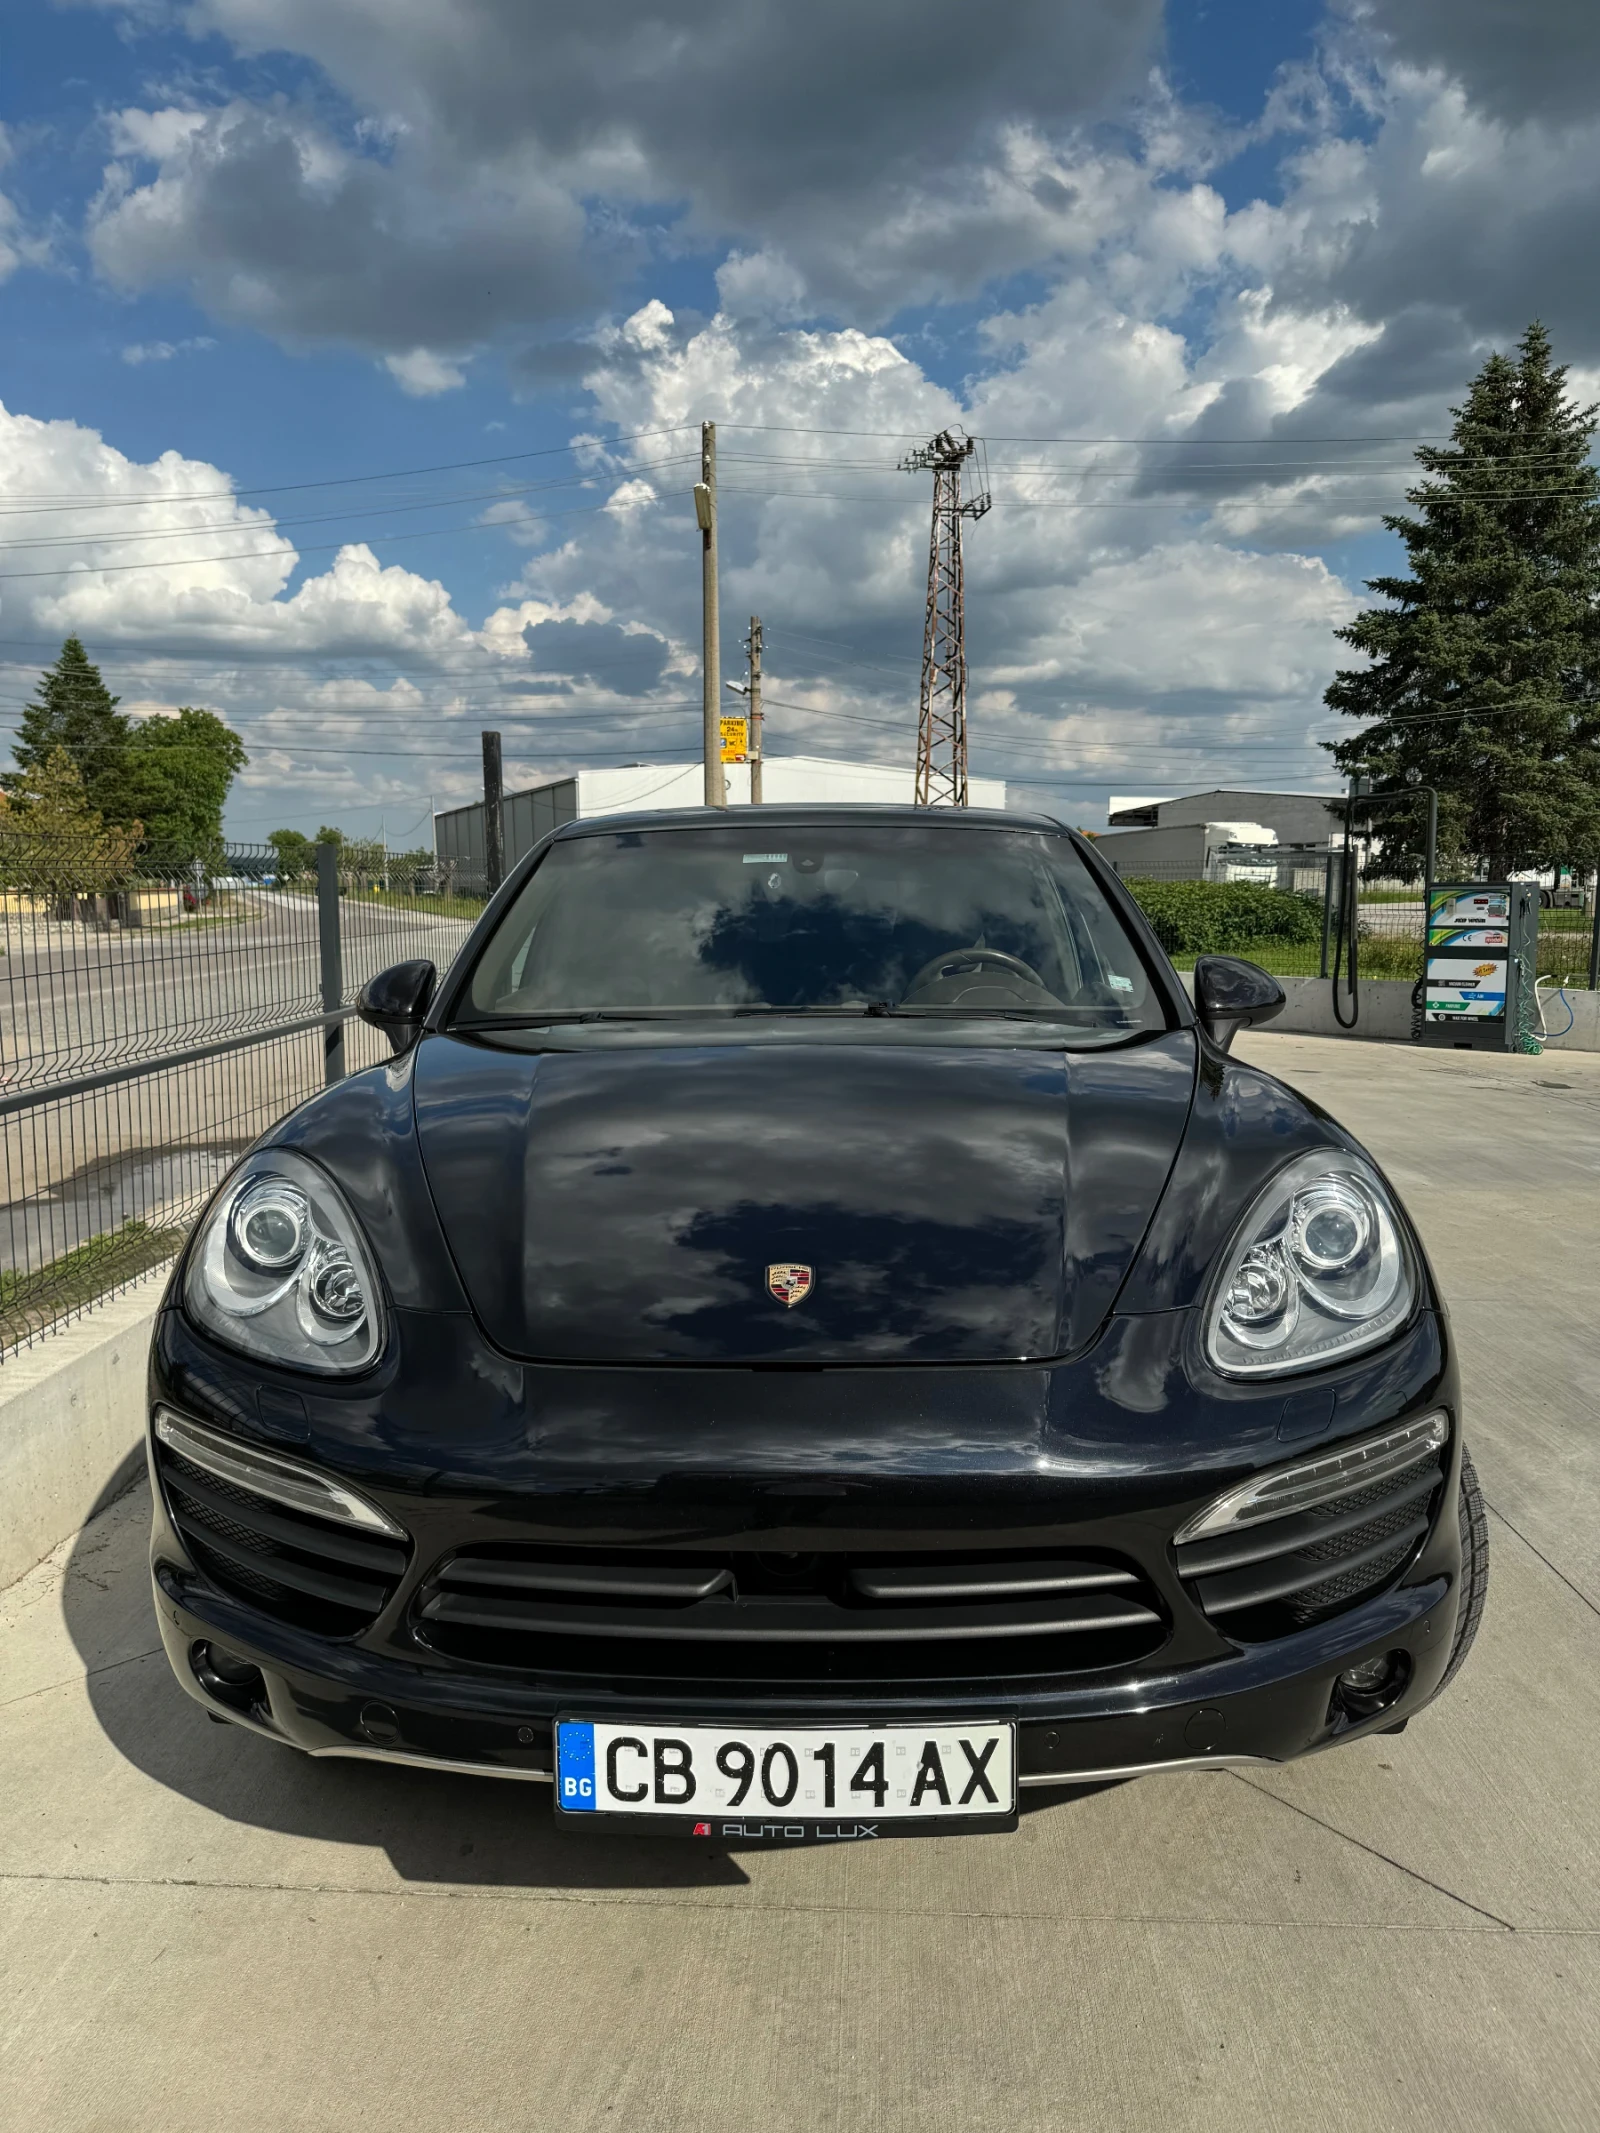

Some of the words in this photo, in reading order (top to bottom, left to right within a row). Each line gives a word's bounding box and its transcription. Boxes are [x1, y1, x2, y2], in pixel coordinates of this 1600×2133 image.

[606, 1736, 697, 1804] CB
[716, 1741, 890, 1808] 9014
[909, 1738, 1000, 1807] AX
[564, 1777, 592, 1797] BG
[722, 1824, 804, 1837] AUTO
[816, 1825, 879, 1838] LUX
